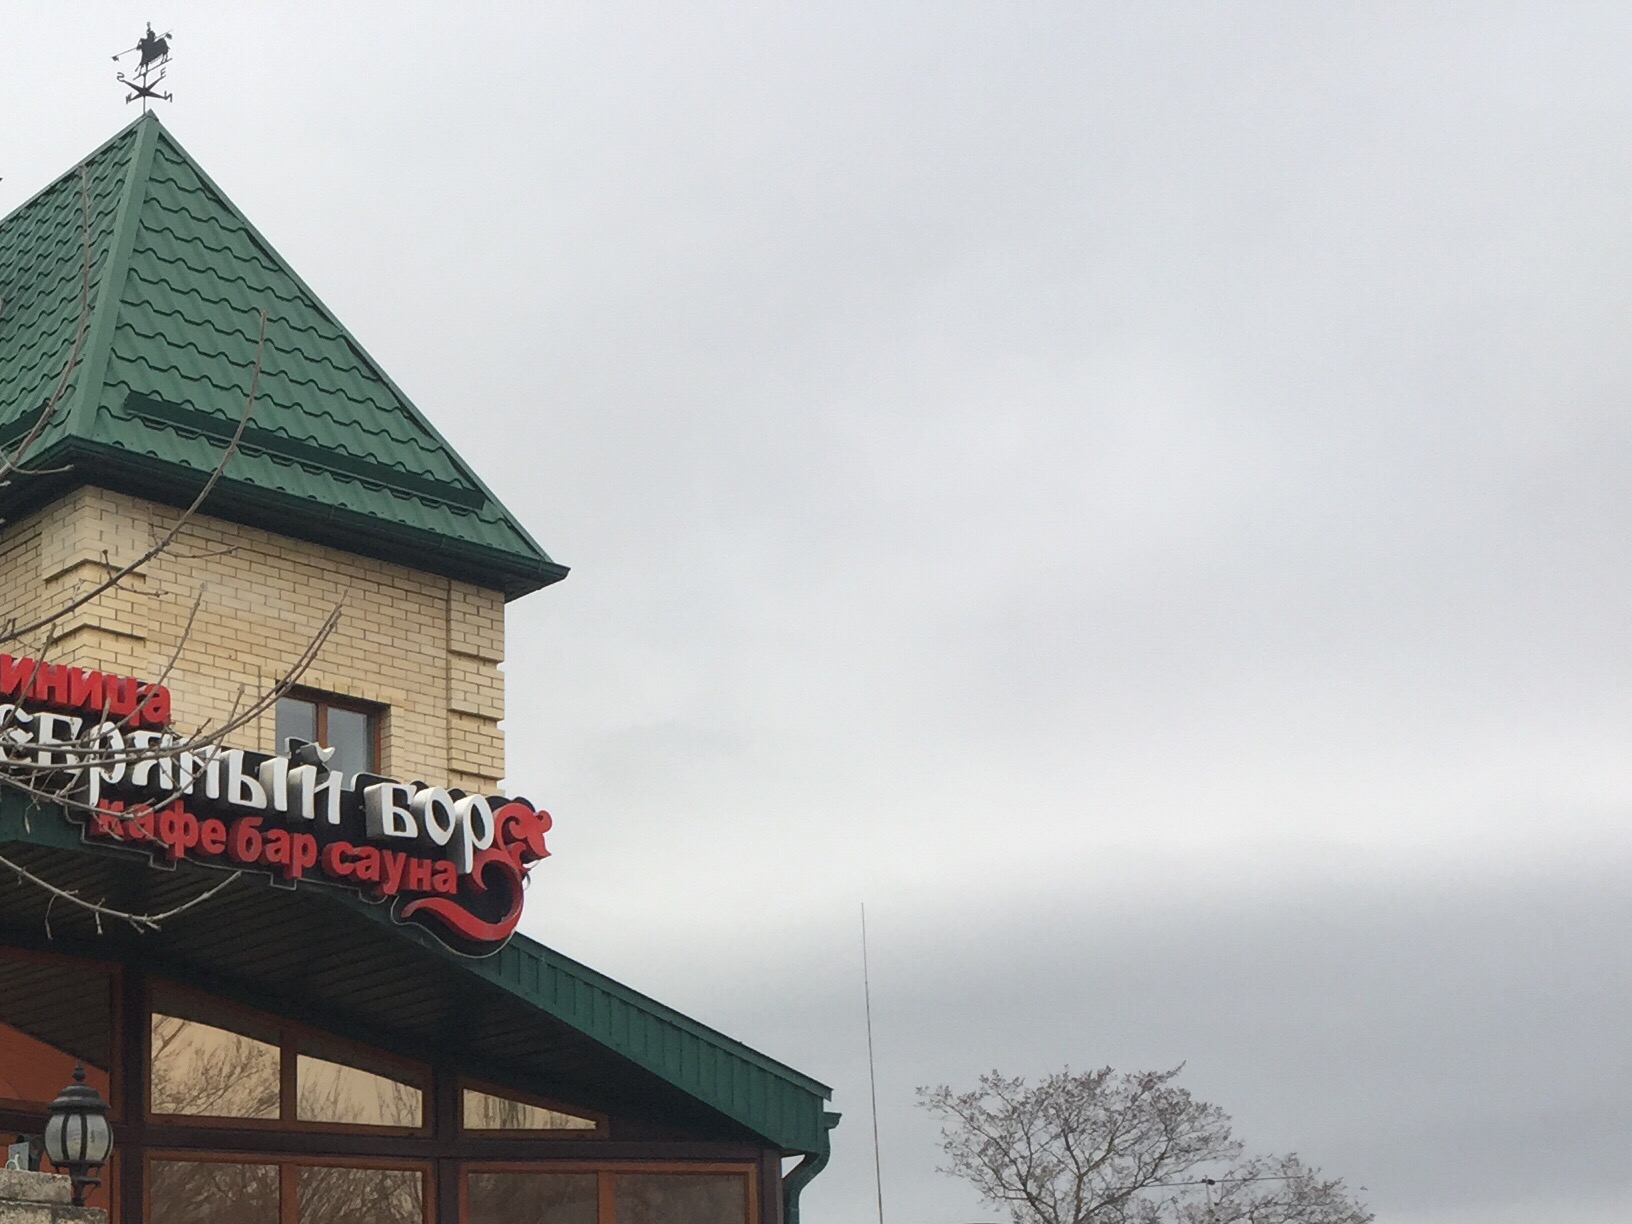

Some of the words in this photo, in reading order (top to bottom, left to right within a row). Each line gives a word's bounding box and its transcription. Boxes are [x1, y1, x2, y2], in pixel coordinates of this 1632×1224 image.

[93, 798, 227, 858] кафе
[232, 817, 318, 878] бар
[323, 841, 458, 895] сауна
